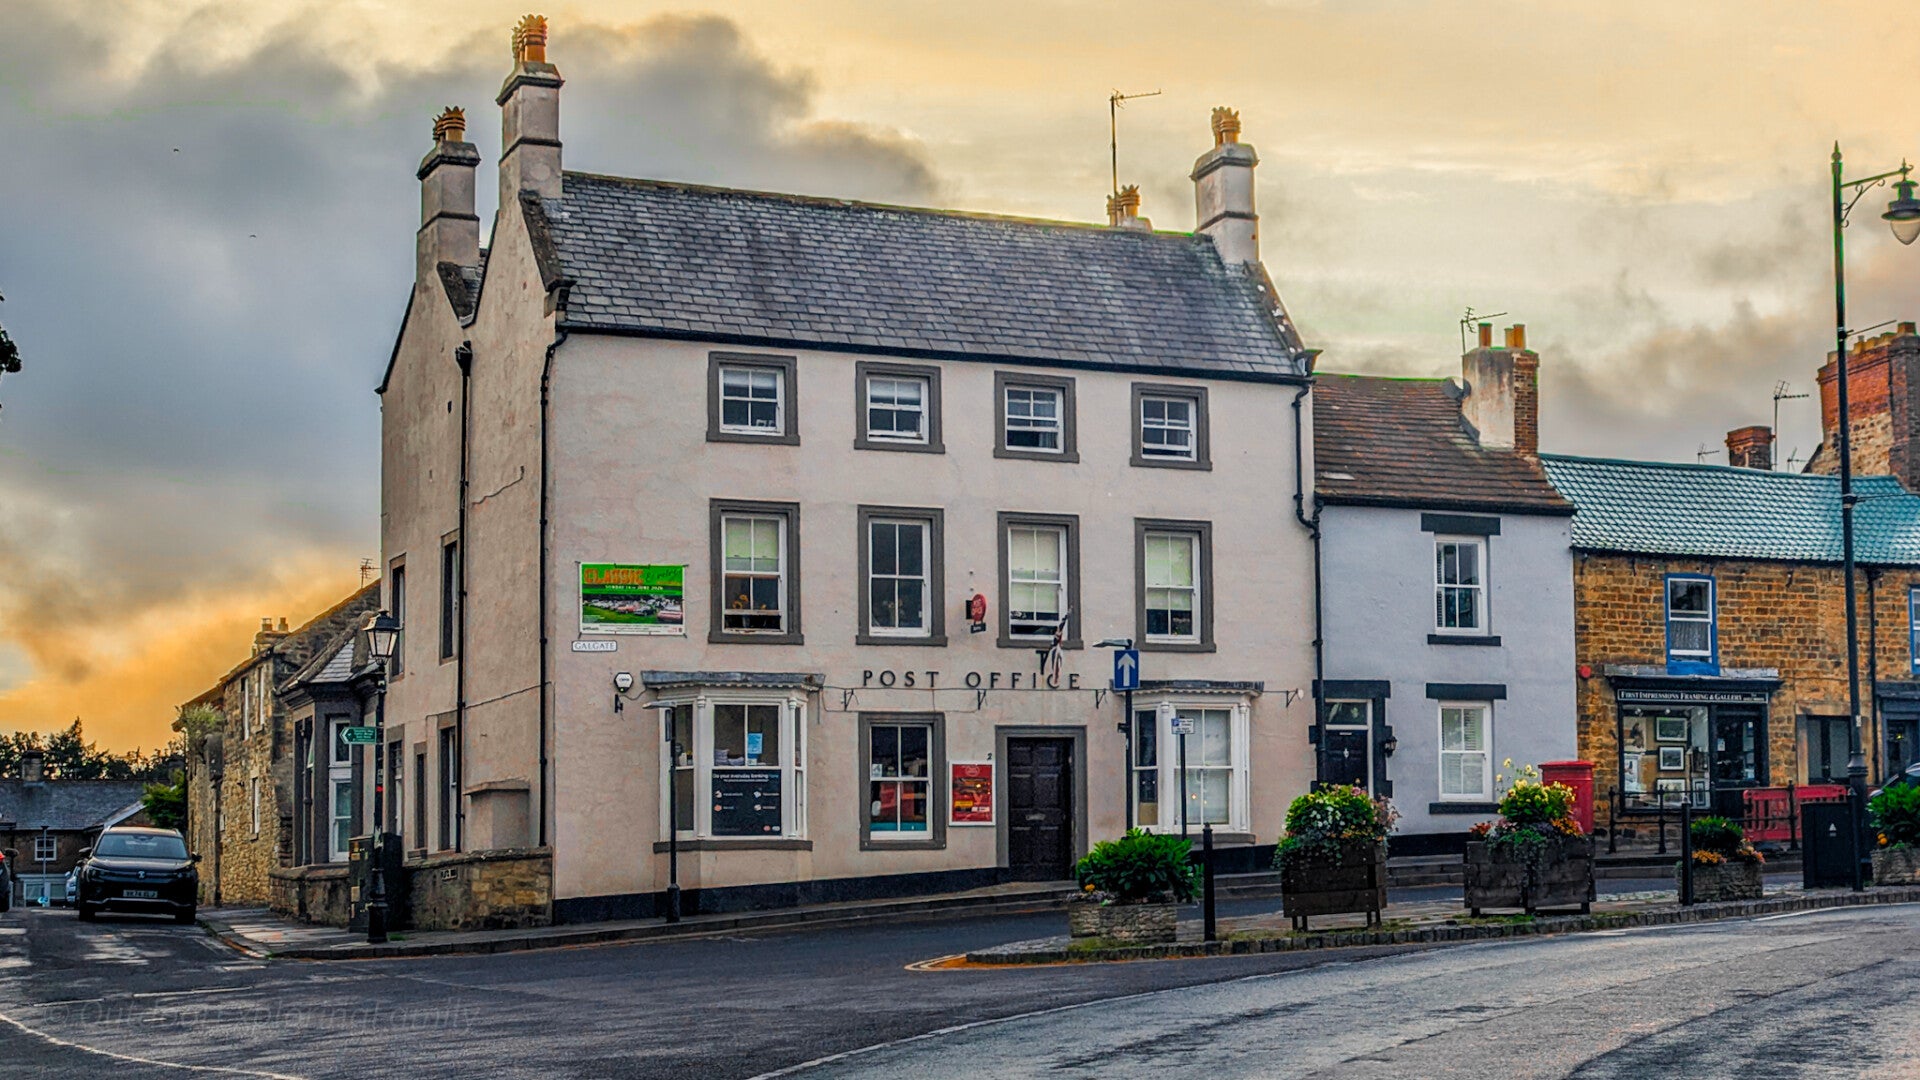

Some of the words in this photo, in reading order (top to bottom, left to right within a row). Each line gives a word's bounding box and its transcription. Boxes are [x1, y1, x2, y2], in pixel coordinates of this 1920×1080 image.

[584, 568, 645, 585] CLASSIC
[574, 641, 615, 651] GALGATE
[863, 670, 940, 688] POST
[965, 671, 1080, 690] OFFICE
[1621, 690, 1639, 699] FIRST
[1639, 691, 1679, 700] IMPRESSIONS
[1680, 692, 1709, 701] FRAMING
[1714, 692, 1742, 701] GALLERY
